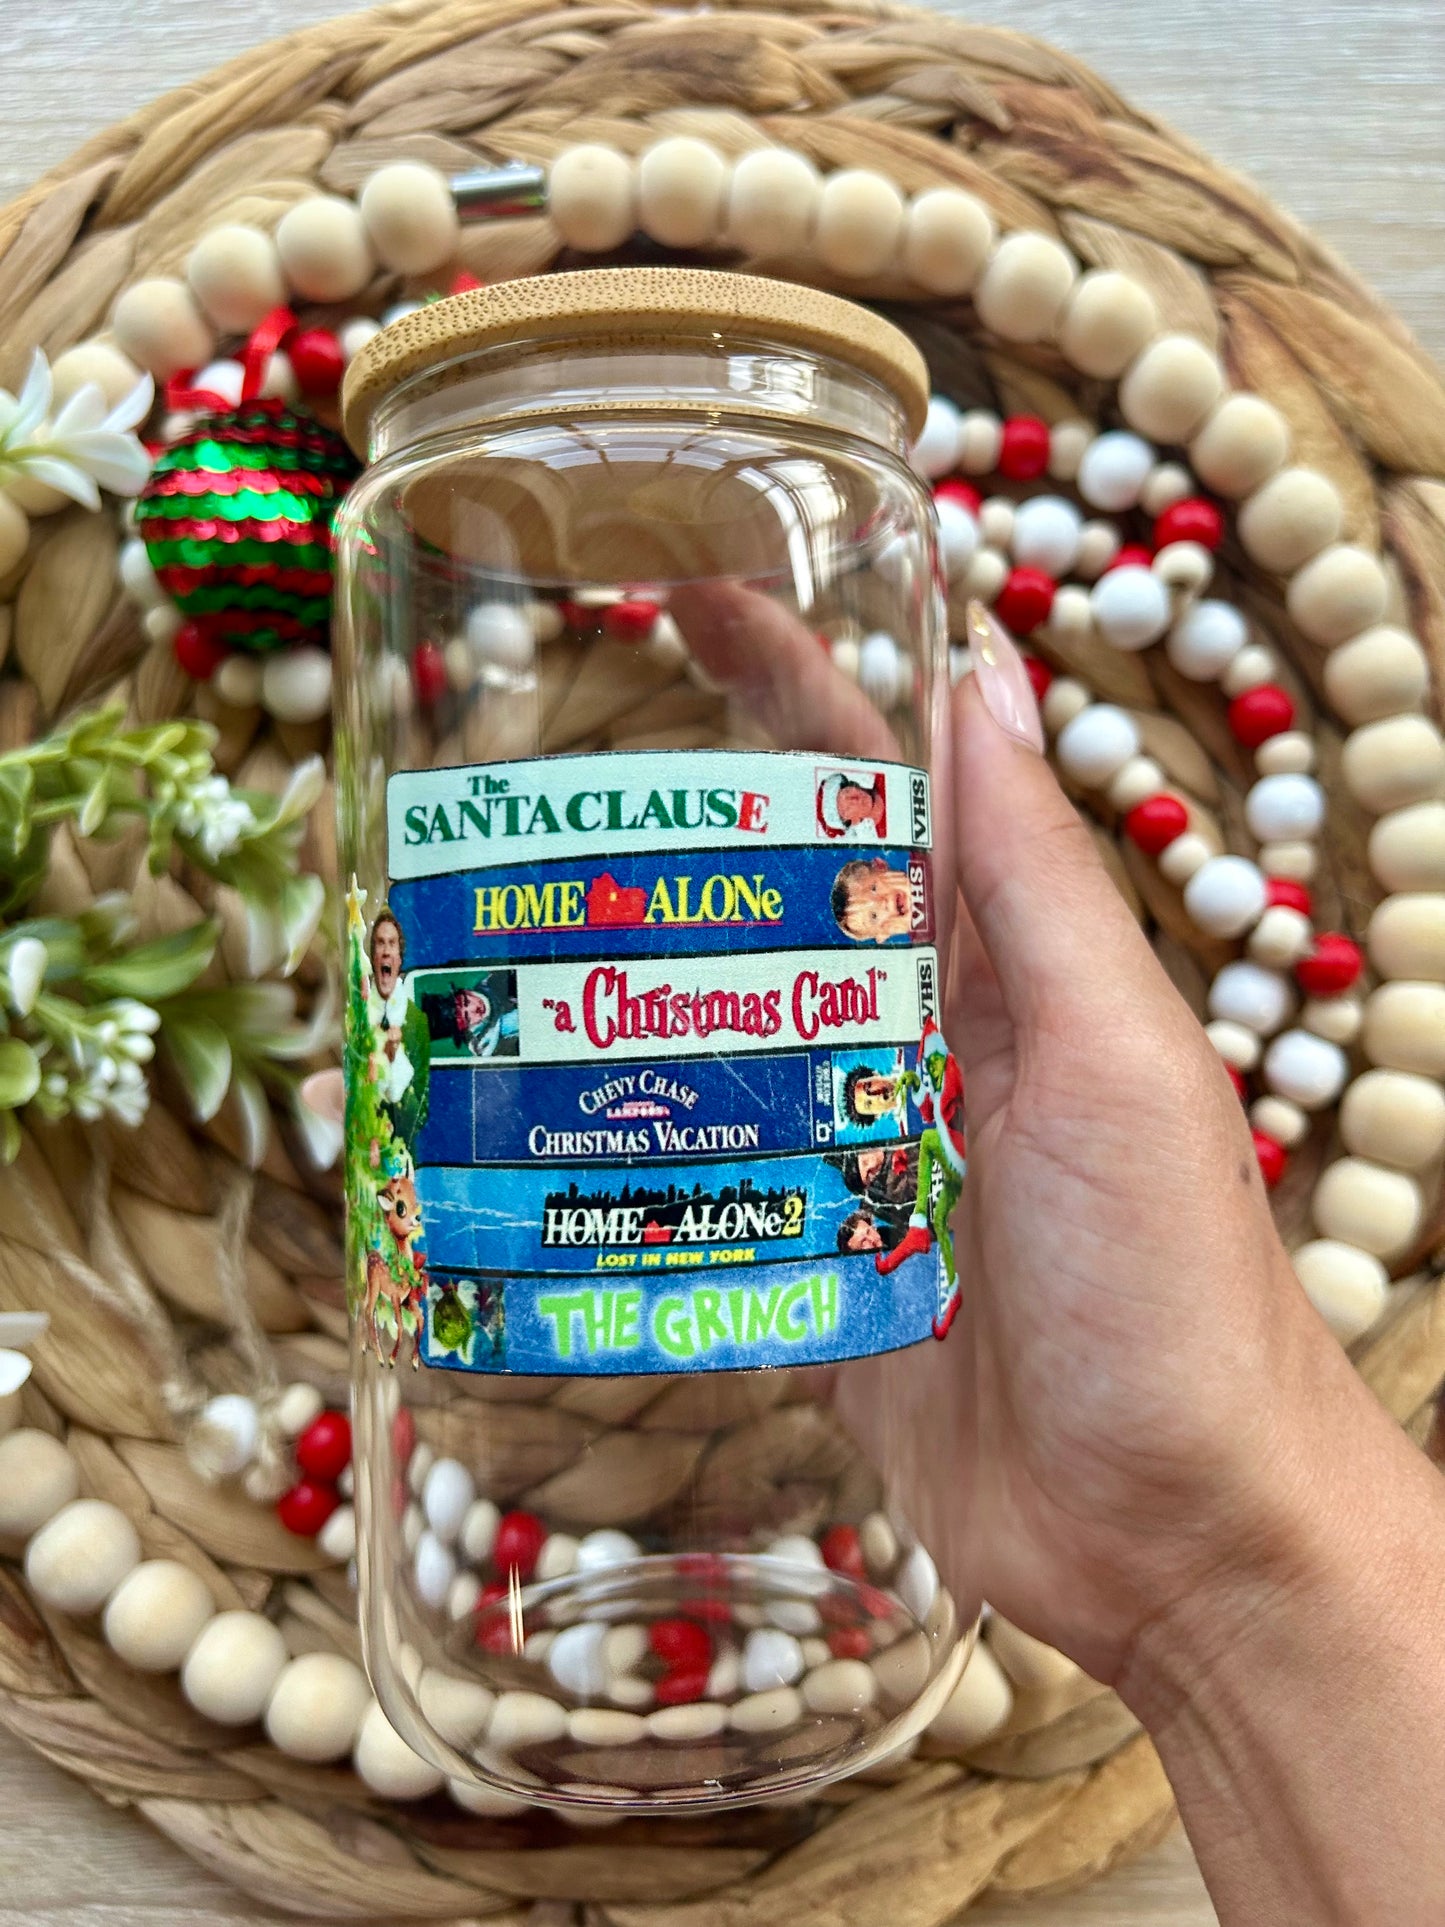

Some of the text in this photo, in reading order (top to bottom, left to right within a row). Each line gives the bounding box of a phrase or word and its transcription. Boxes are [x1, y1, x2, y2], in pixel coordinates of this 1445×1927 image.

[467, 774, 511, 797] The
[912, 778, 928, 842] VHS
[472, 880, 587, 932] HOME
[909, 865, 925, 930] VHS
[582, 965, 782, 1050] Christmas
[920, 963, 934, 1026] VHS
[578, 1069, 700, 1115] CHEVY CHASE
[528, 1120, 760, 1156] CHRISTMAS VACATION
[543, 1206, 645, 1245] HOME
[596, 1247, 756, 1268] LOST IN NEW YORK
[539, 1273, 839, 1359] THE GRINCH
